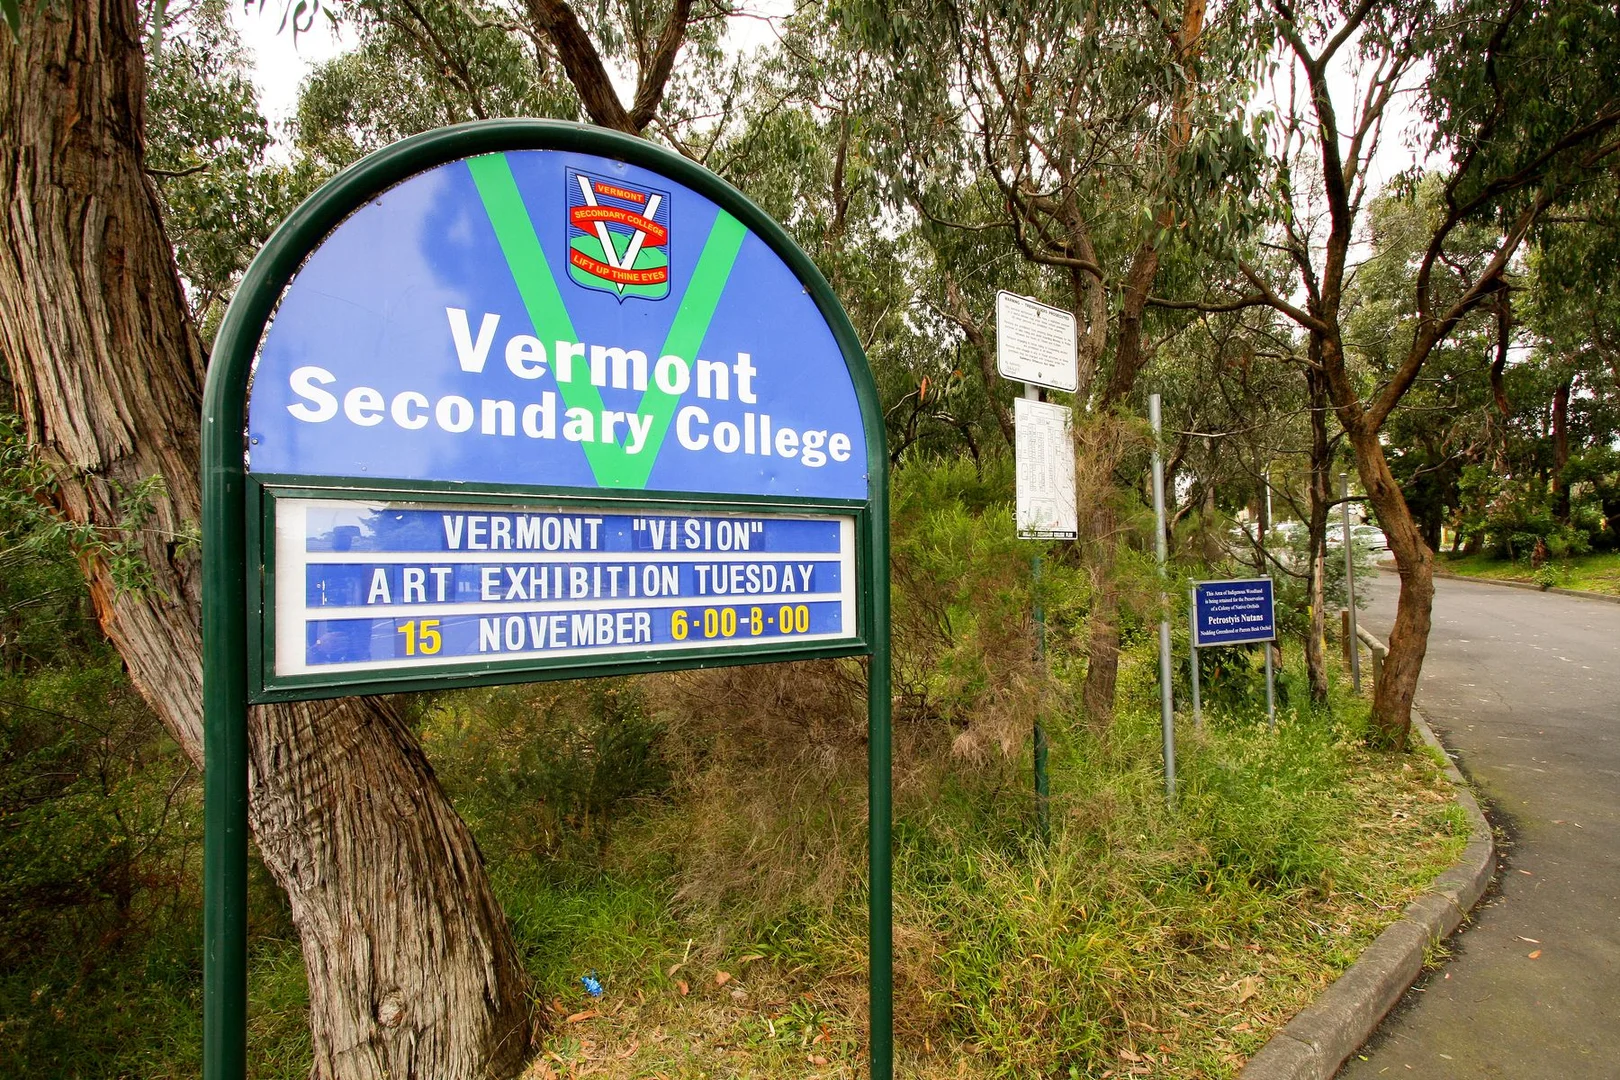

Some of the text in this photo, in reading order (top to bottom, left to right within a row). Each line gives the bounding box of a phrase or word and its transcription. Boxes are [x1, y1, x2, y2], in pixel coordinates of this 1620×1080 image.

[597, 184, 643, 201] VERMONT
[574, 209, 665, 237] SECONDARY COLLEGE
[573, 254, 665, 281] LIFT UP THINE EYES
[445, 306, 758, 405] Vermont
[286, 364, 852, 468] Secondary College
[443, 515, 763, 551] VERMONT "VISION"
[367, 564, 814, 605] ART EXHIBITION TUESDAY
[397, 620, 443, 656] 15
[479, 612, 653, 652] NOVEMBER
[1241, 614, 1264, 622] Nutans
